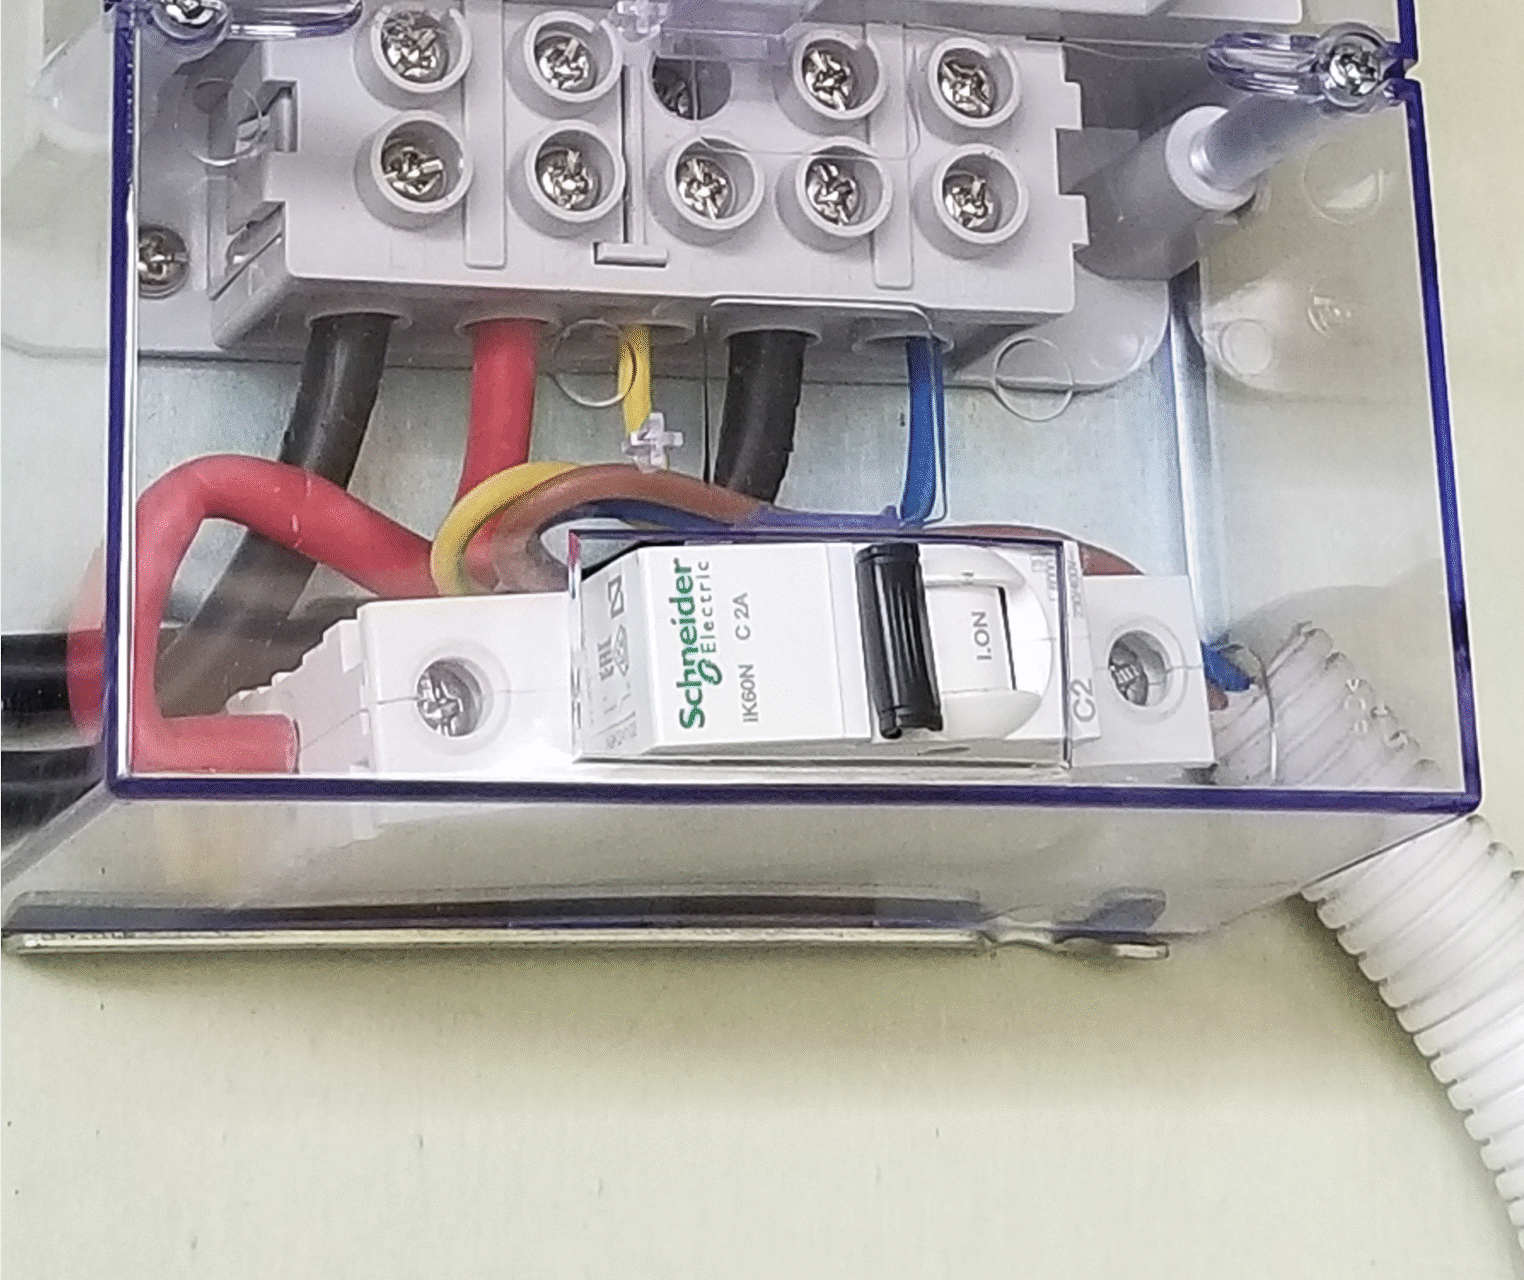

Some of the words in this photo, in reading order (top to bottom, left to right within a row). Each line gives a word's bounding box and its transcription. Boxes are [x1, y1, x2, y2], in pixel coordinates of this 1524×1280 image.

[695, 560, 718, 653] Electric
[732, 592, 751, 620] 2A
[667, 557, 706, 729] Schneider
[734, 624, 752, 641] C
[737, 663, 760, 723] IK60N
[1070, 678, 1097, 723] C2
